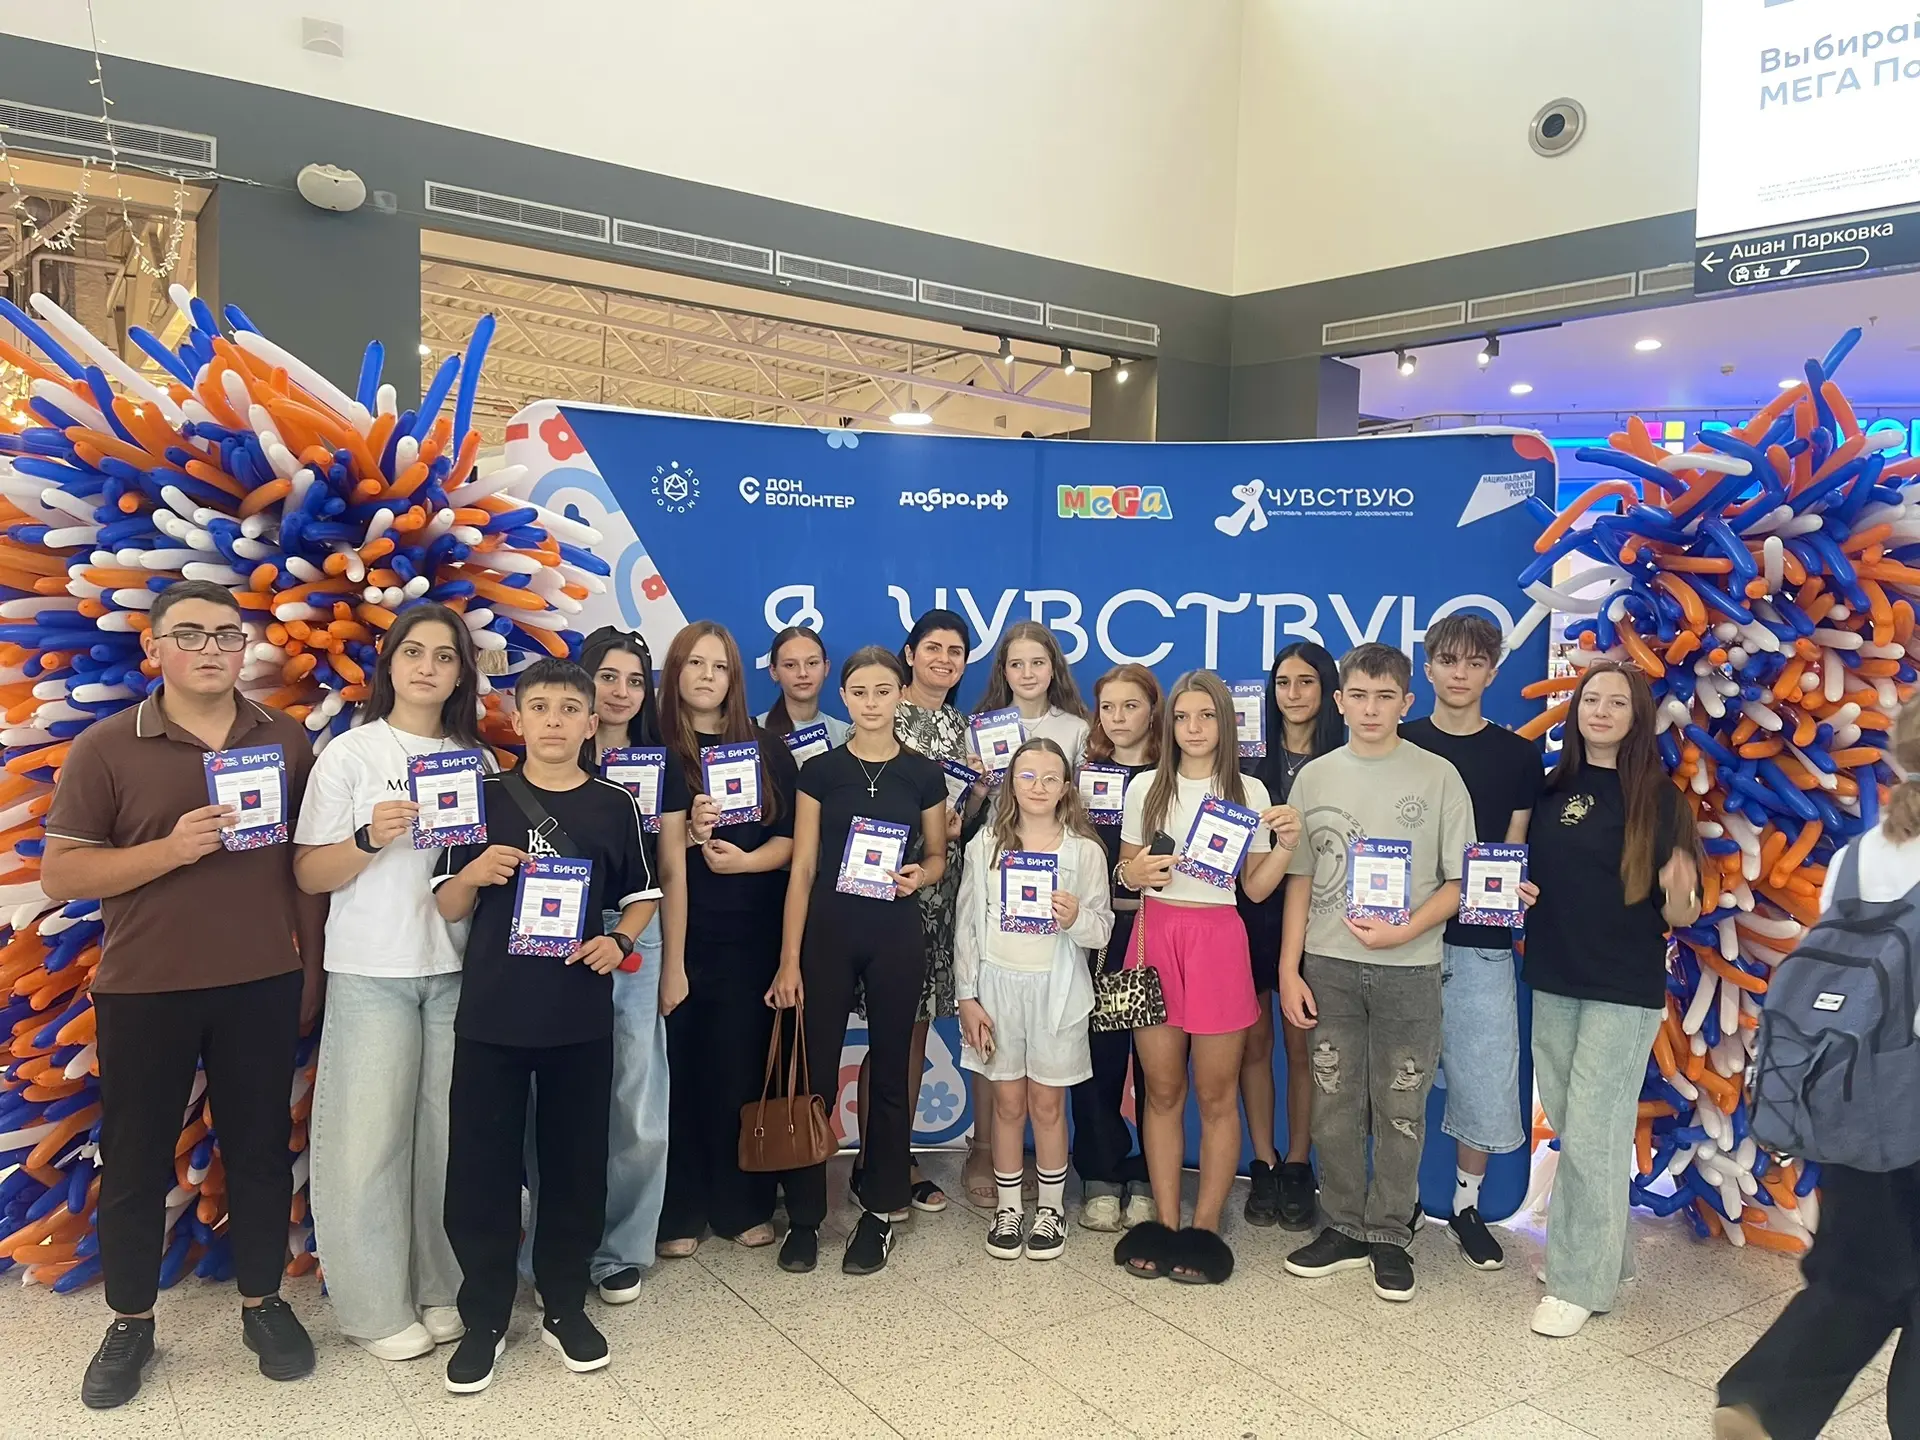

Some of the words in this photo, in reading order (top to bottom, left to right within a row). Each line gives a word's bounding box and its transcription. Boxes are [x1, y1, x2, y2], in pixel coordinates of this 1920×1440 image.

[1759, 67, 1861, 110] МЕГА
[1729, 238, 1786, 260] Ашан
[1792, 221, 1894, 251] Парковка
[765, 477, 803, 493] ДОН
[1504, 480, 1534, 491] ПРОЕКТЫ
[1266, 487, 1414, 507] ЧУВСТВУЮ
[1509, 487, 1534, 497] РОССИИ
[765, 493, 855, 509] ВОЛОНТЕР
[899, 487, 1009, 512] добро.рф
[1234, 684, 1263, 693] БИНГО
[799, 728, 825, 742] БИНГО
[241, 752, 280, 765] БИНГО
[631, 753, 663, 761] БИНГО
[727, 747, 756, 758] БИНГО
[441, 756, 478, 768] БИНГО
[1227, 808, 1257, 826] БИНГО
[877, 825, 906, 837] БИНГО
[1377, 844, 1409, 855] БИНГО
[1492, 848, 1525, 858] БИНГО
[1026, 857, 1055, 868] БИНГО
[553, 864, 588, 876] БИНГО
